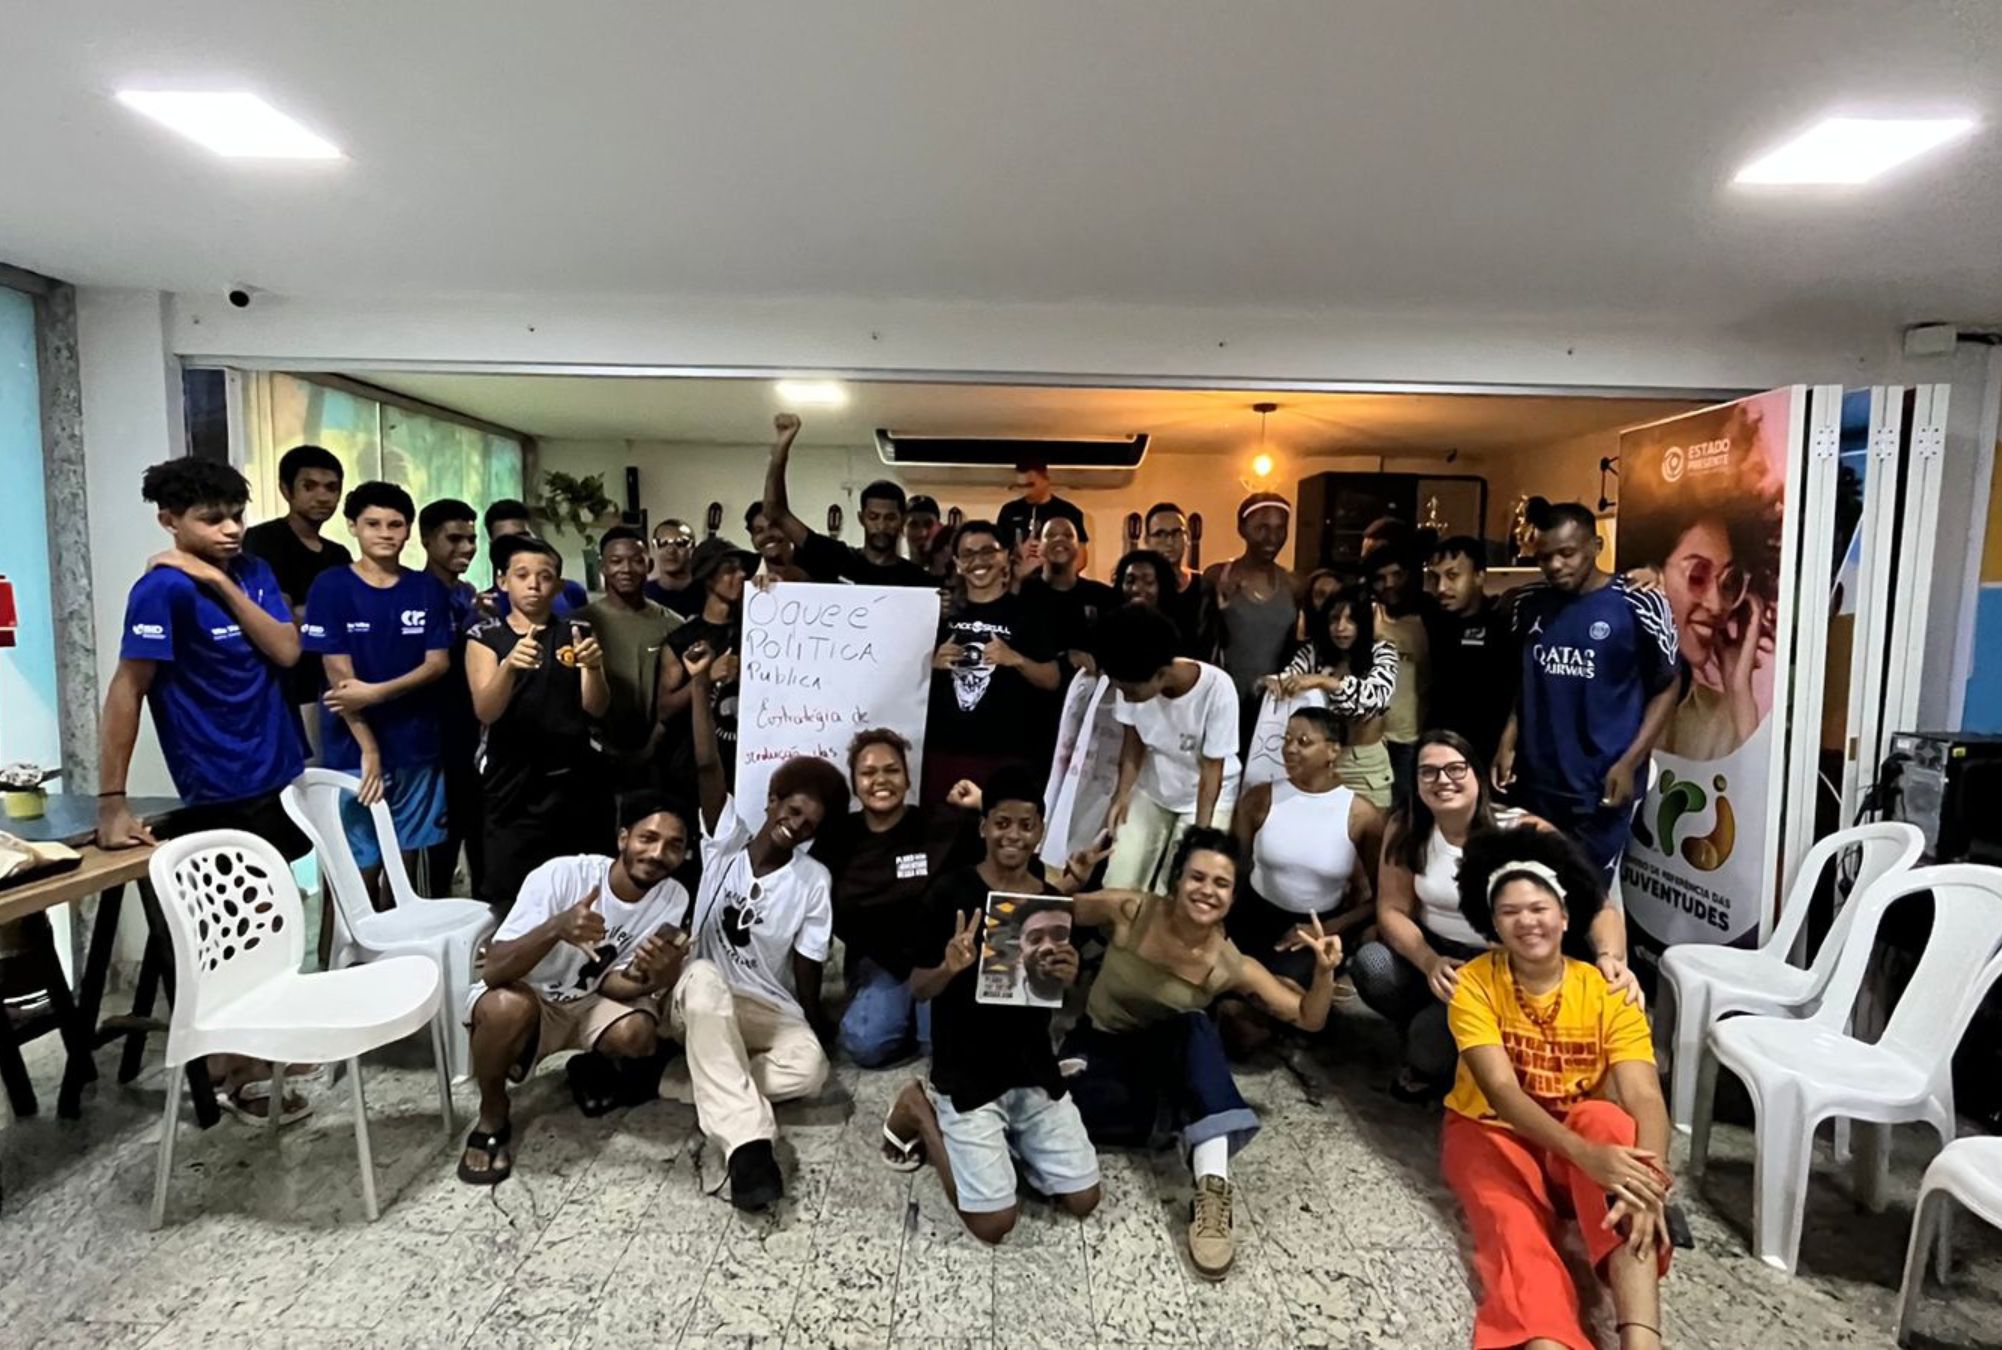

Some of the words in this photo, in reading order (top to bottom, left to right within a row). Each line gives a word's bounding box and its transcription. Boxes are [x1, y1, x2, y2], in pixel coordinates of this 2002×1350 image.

[1688, 438, 1730, 459] ESTADO
[1621, 866, 1730, 932] JUVENTUDES
[1711, 891, 1731, 910] DAS
